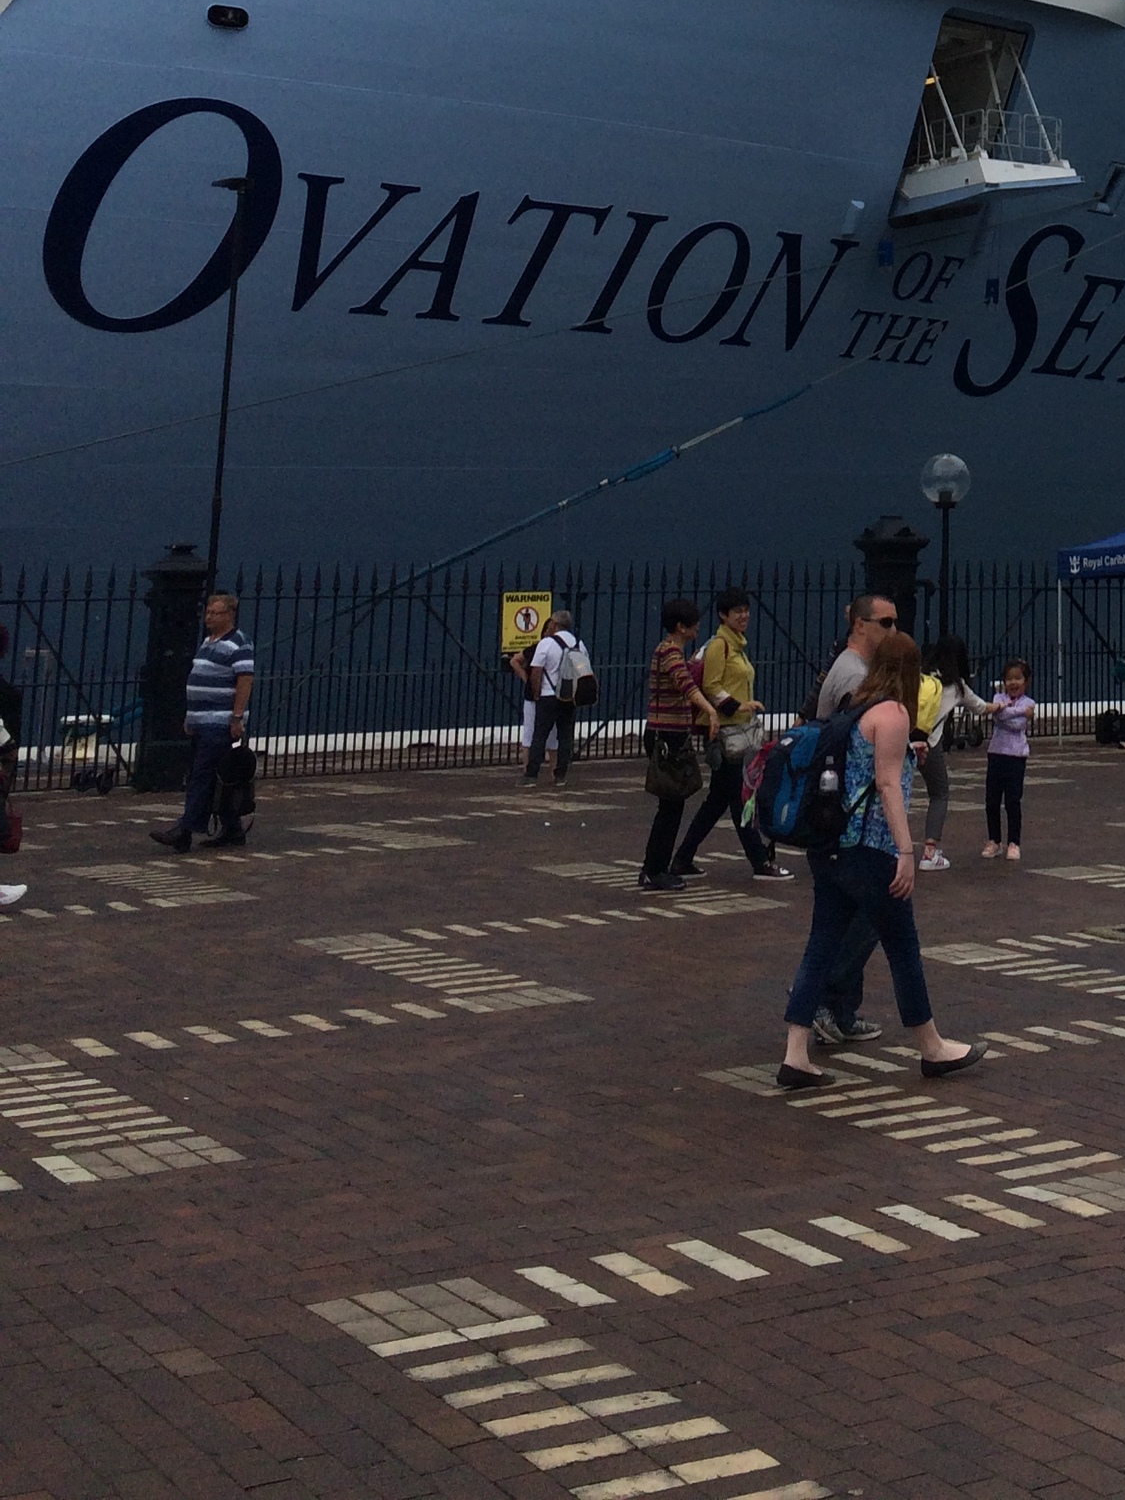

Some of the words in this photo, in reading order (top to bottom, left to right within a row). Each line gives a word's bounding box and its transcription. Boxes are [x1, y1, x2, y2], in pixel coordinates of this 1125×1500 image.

[42, 96, 860, 352] OVATION
[890, 250, 964, 303] OF
[839, 308, 948, 366] THE
[1083, 556, 1103, 570] Royal
[505, 594, 550, 603] WARNING
